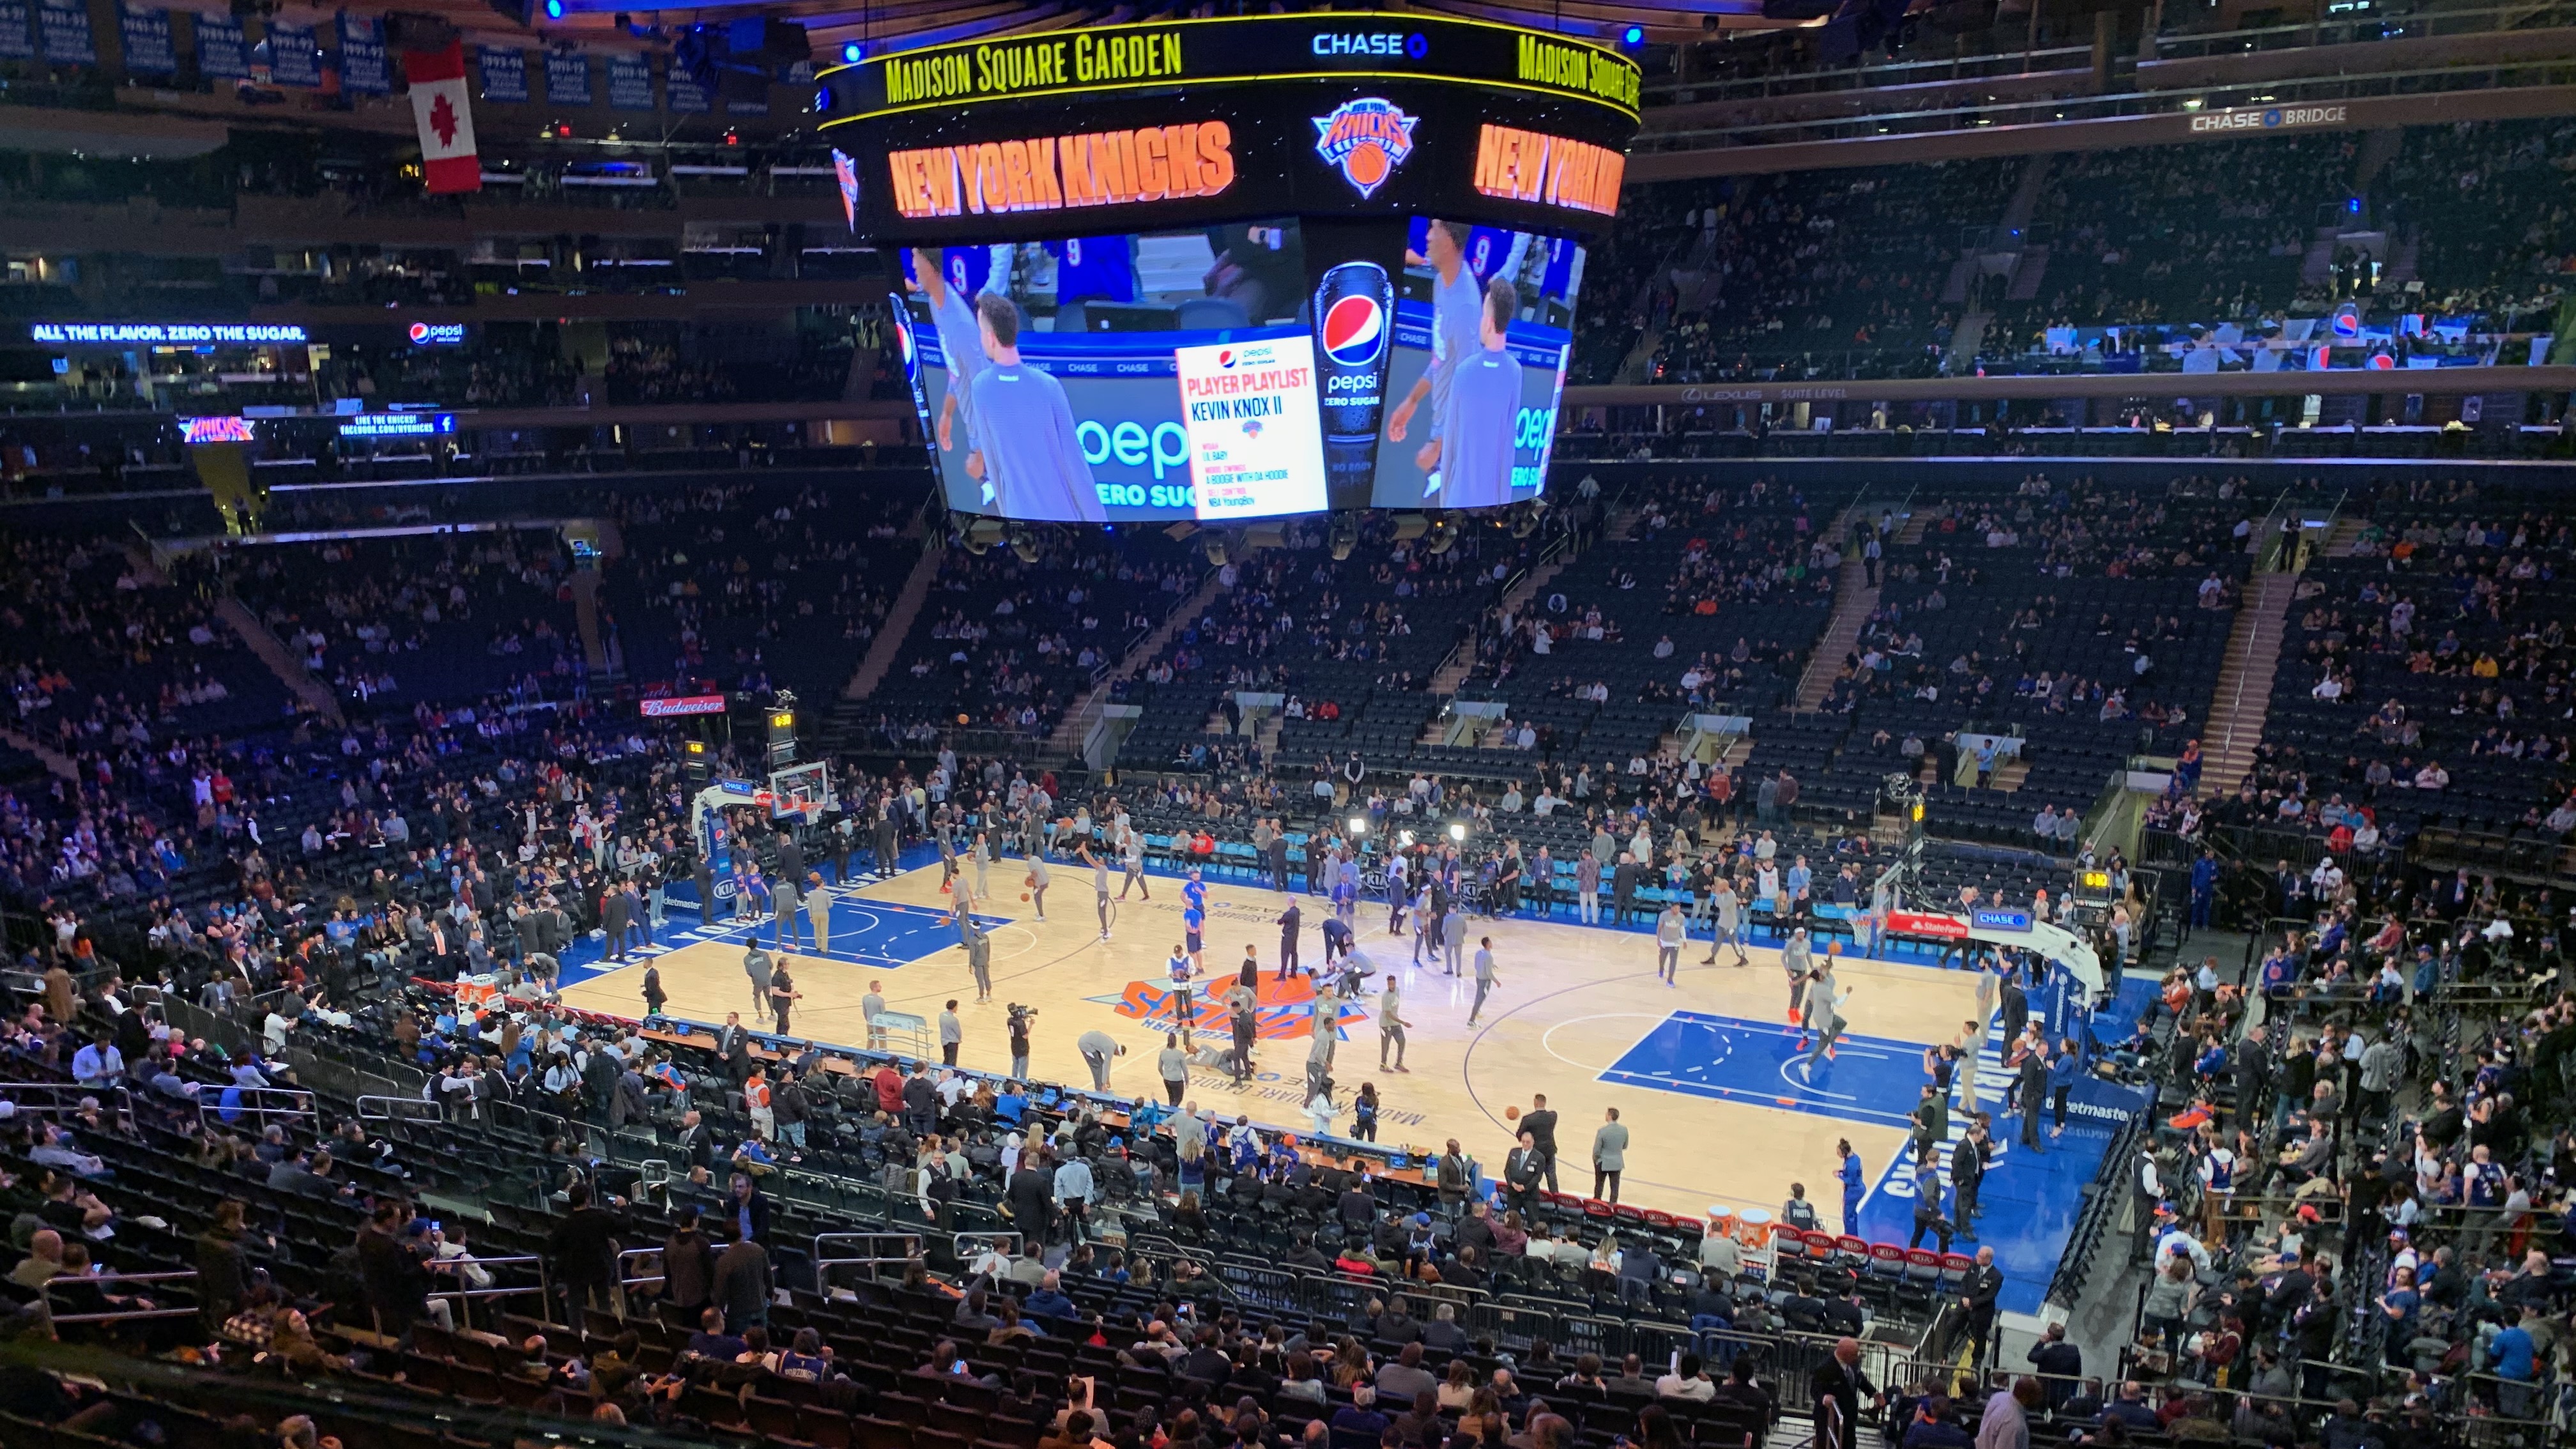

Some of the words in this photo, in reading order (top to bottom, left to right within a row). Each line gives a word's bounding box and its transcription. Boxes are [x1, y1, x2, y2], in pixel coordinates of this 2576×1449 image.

[1313, 33, 1404, 55] CHASE
[885, 54, 971, 104] MADISON
[977, 44, 1068, 94] SQUARE
[1075, 33, 1182, 82] GARDEN
[1519, 34, 1588, 89] MADISON
[1323, 112, 1407, 148] KNICKS
[2193, 112, 2260, 131] CHASE
[2286, 107, 2347, 124] BRIDGE
[889, 147, 962, 218] NEW
[955, 137, 1062, 214] YORK
[1059, 121, 1234, 208] KNICKS
[1474, 124, 1549, 203] NEW
[34, 325, 65, 341] ALL
[65, 325, 98, 342] THE
[100, 325, 166, 342] FLAVOR.
[167, 325, 211, 341] ZERO
[213, 325, 246, 341] THE
[247, 325, 305, 342] SUGAR.
[431, 323, 463, 338] pepsi
[1068, 363, 1098, 373] CHASE
[1117, 363, 1149, 373] CHASE
[1187, 376, 1239, 397] PLAYER
[1242, 367, 1308, 392] PLAYLIST
[1328, 372, 1378, 394] pepsi
[1815, 388, 1846, 398] LEVEL
[1192, 401, 1230, 422] KEVIN
[1234, 397, 1270, 419] KNOX
[1274, 395, 1283, 415] II
[191, 417, 249, 440] KNICKS
[355, 416, 371, 425] LIKE
[372, 415, 386, 424] THE
[641, 700, 723, 716] Budweiser
[724, 782, 744, 791] CHASE
[717, 883, 736, 896] KIA
[1980, 913, 2014, 925] CHASE
[1793, 1209, 1811, 1219] PHOTO
